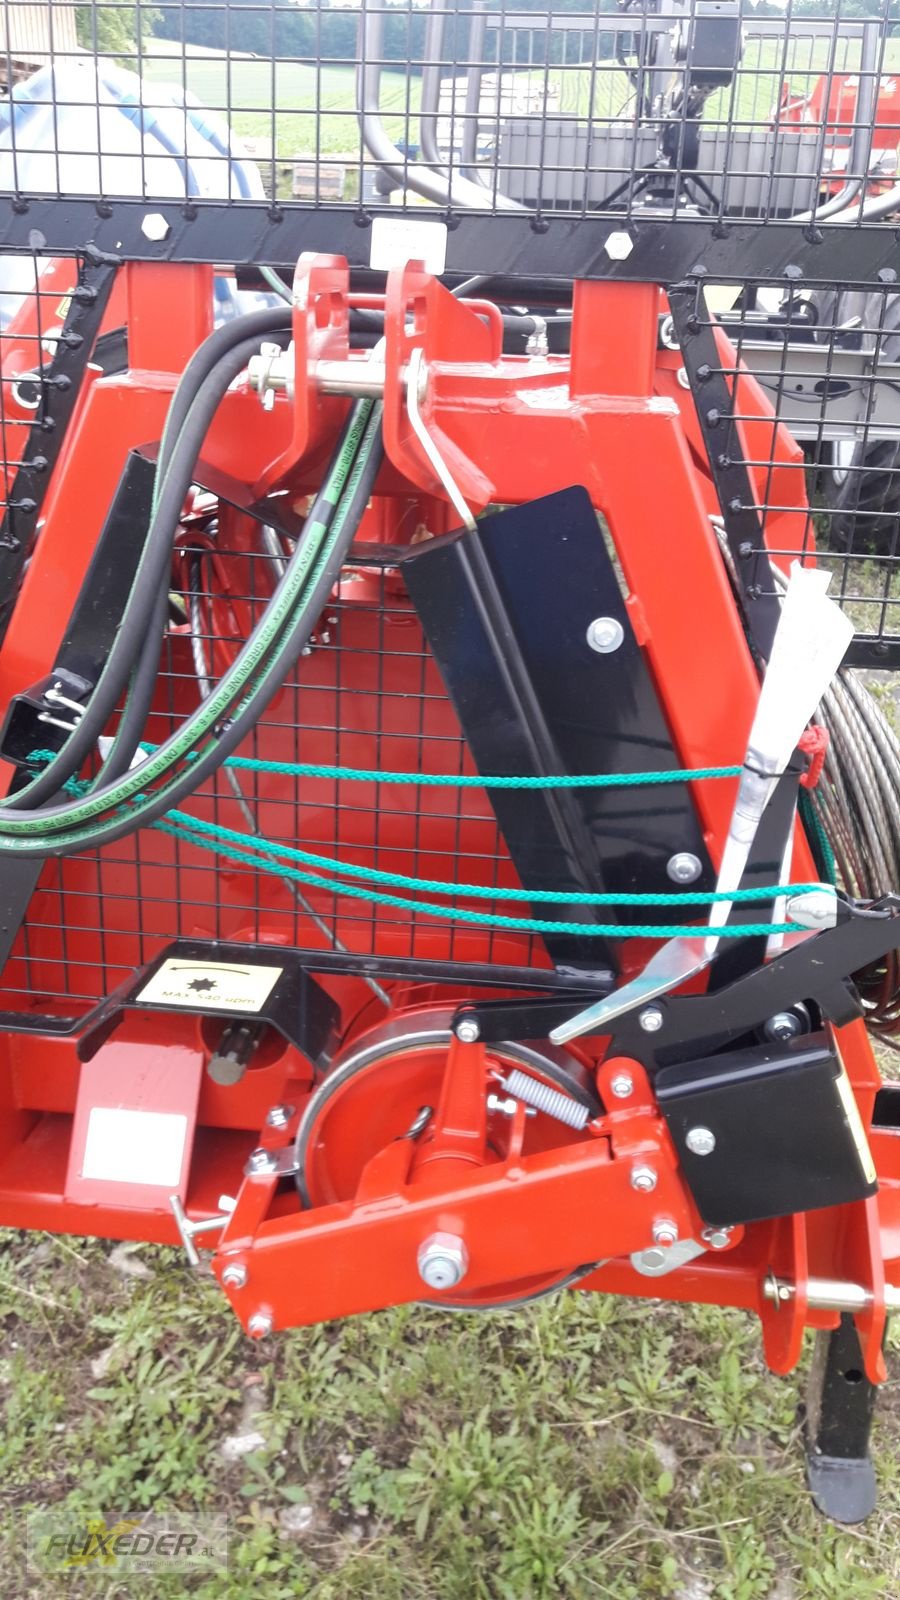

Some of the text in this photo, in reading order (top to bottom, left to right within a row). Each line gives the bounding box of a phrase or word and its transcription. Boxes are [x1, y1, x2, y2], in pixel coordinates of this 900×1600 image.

[224, 639, 266, 693] GREENLINE
[207, 689, 231, 716] PLUS
[151, 758, 166, 772] 10
[162, 746, 179, 763] DN
